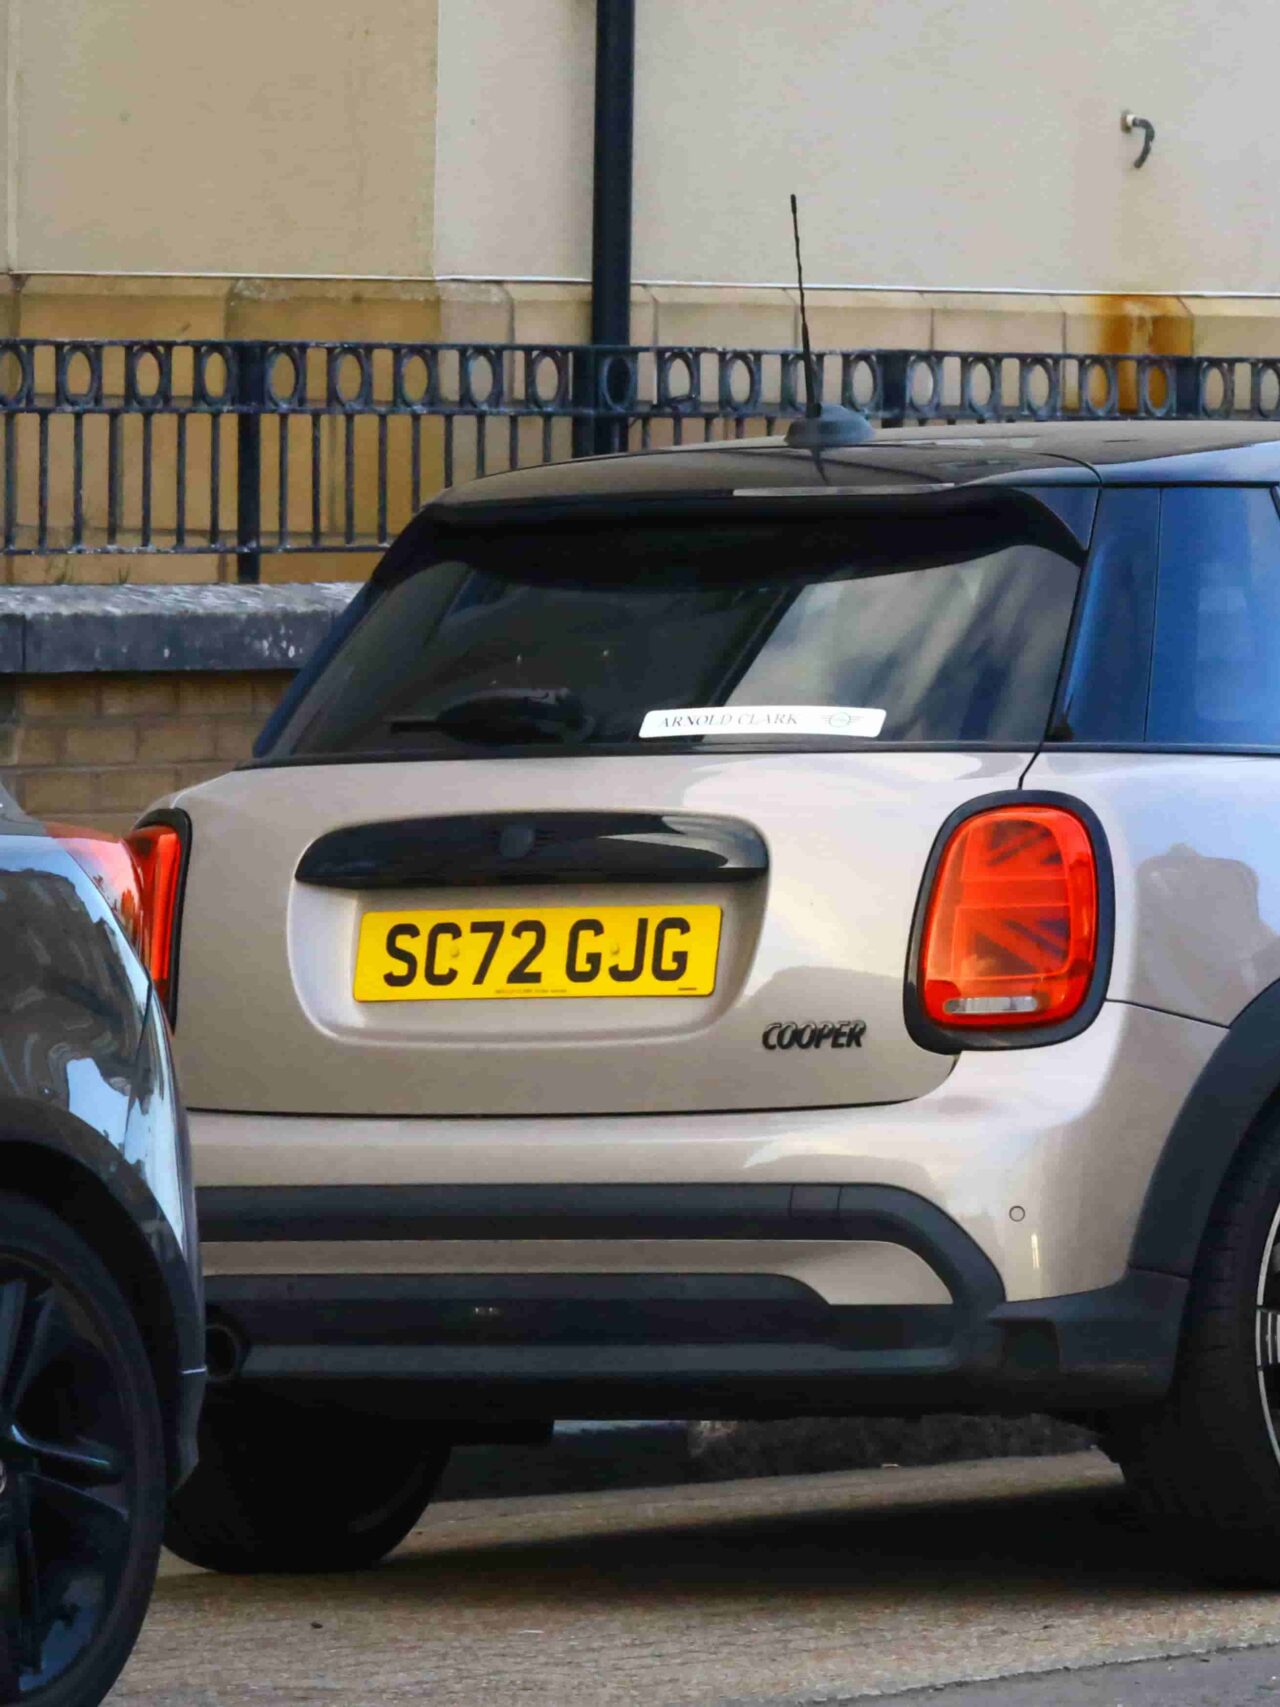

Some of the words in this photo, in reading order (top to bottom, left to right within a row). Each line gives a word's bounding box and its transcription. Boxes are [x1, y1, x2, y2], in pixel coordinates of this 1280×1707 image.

[660, 713, 733, 728] ARNOLD
[736, 713, 798, 726] CLARK
[383, 919, 547, 988] SC72
[565, 916, 691, 983] GJG
[762, 1019, 867, 1050] COOPER
